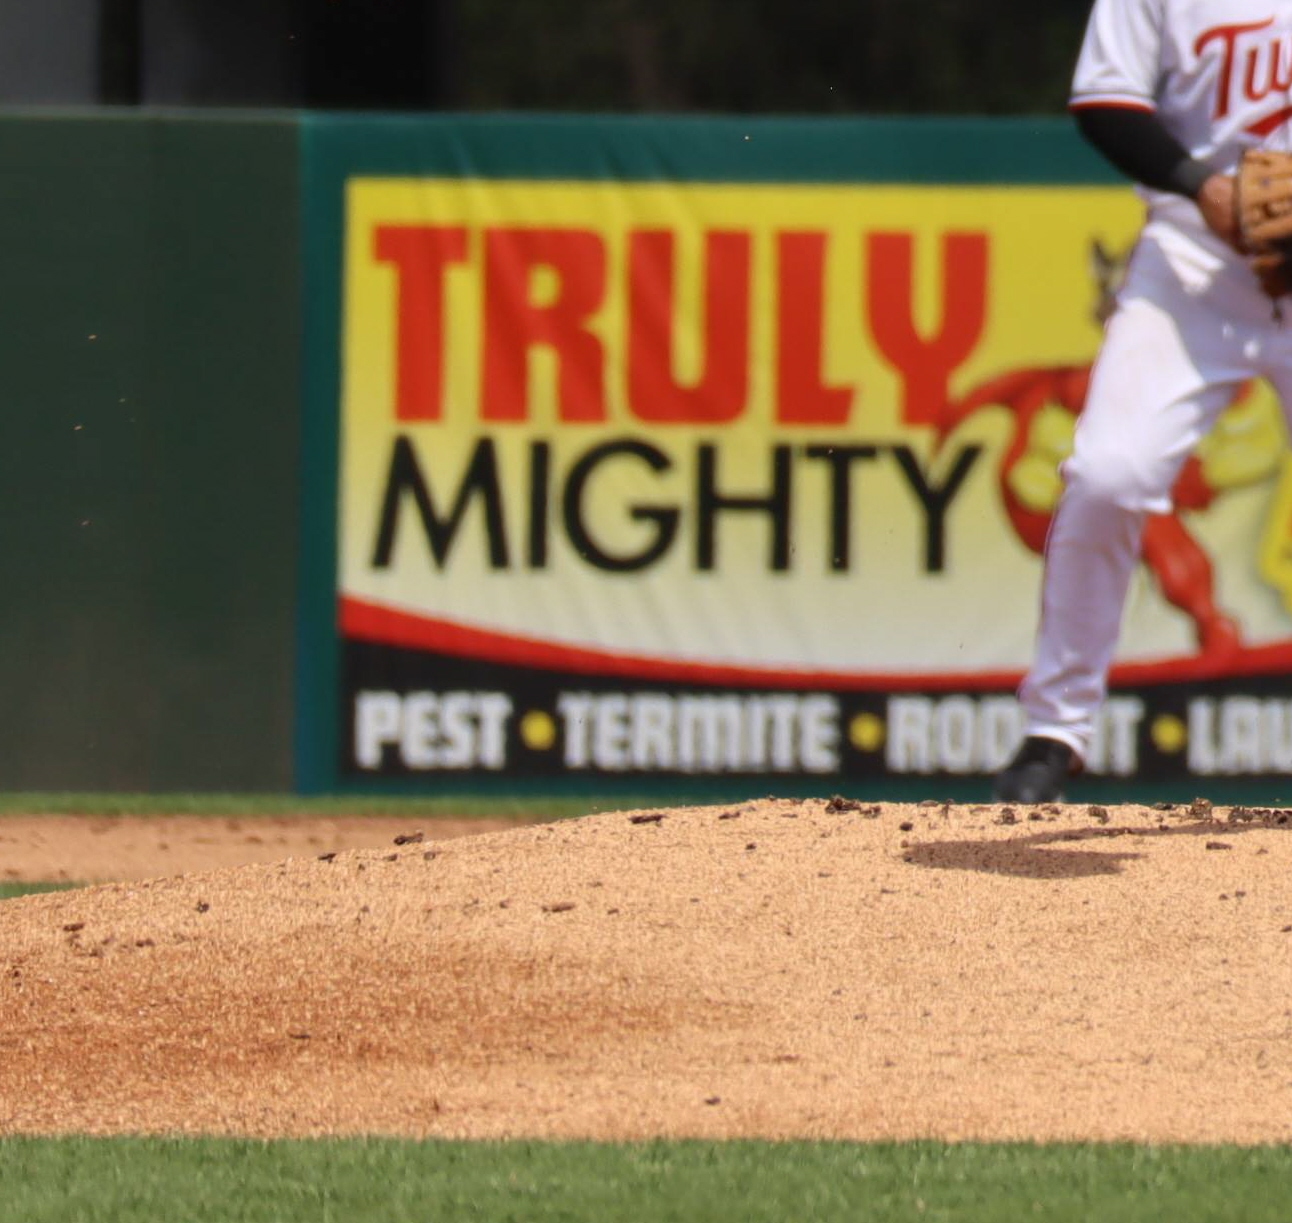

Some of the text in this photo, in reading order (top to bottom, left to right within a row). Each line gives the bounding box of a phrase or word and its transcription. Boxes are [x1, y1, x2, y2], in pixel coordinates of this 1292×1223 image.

[372, 224, 988, 426] TRULY
[371, 434, 984, 574] MIGHTY
[354, 691, 513, 769] PEST
[557, 694, 840, 772] TERMITE
